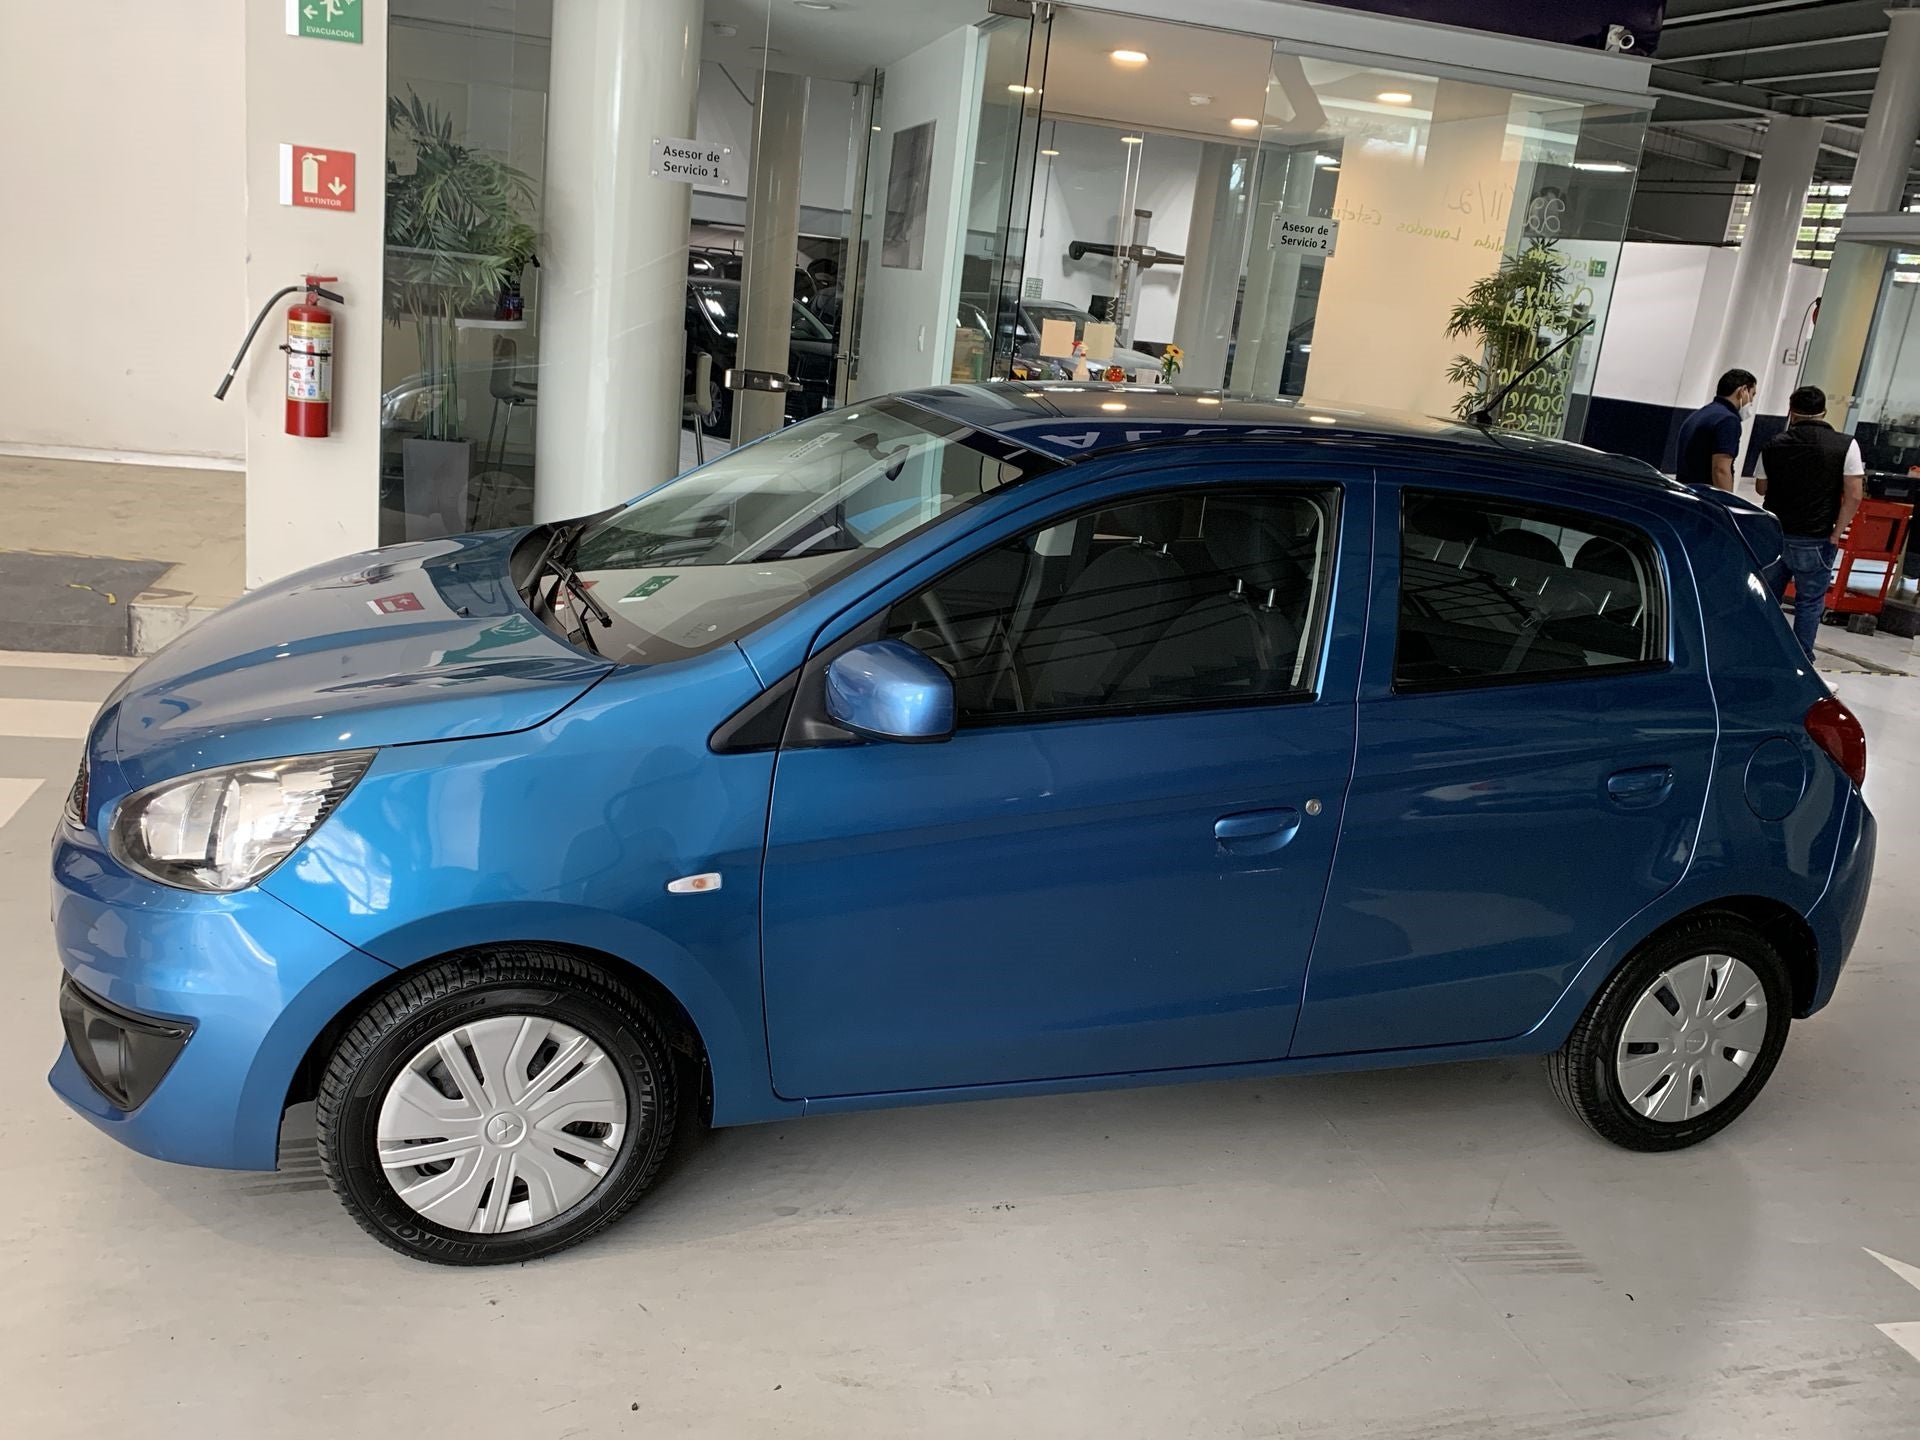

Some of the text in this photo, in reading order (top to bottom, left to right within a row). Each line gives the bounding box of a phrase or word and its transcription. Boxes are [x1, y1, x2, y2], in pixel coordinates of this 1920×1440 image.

[663, 145, 720, 163] Asesor de
[663, 160, 719, 178] Servicio 1
[304, 195, 342, 207] EXTINTOR
[1281, 221, 1329, 235] Asesor de
[1280, 234, 1327, 249] Servicio 2
